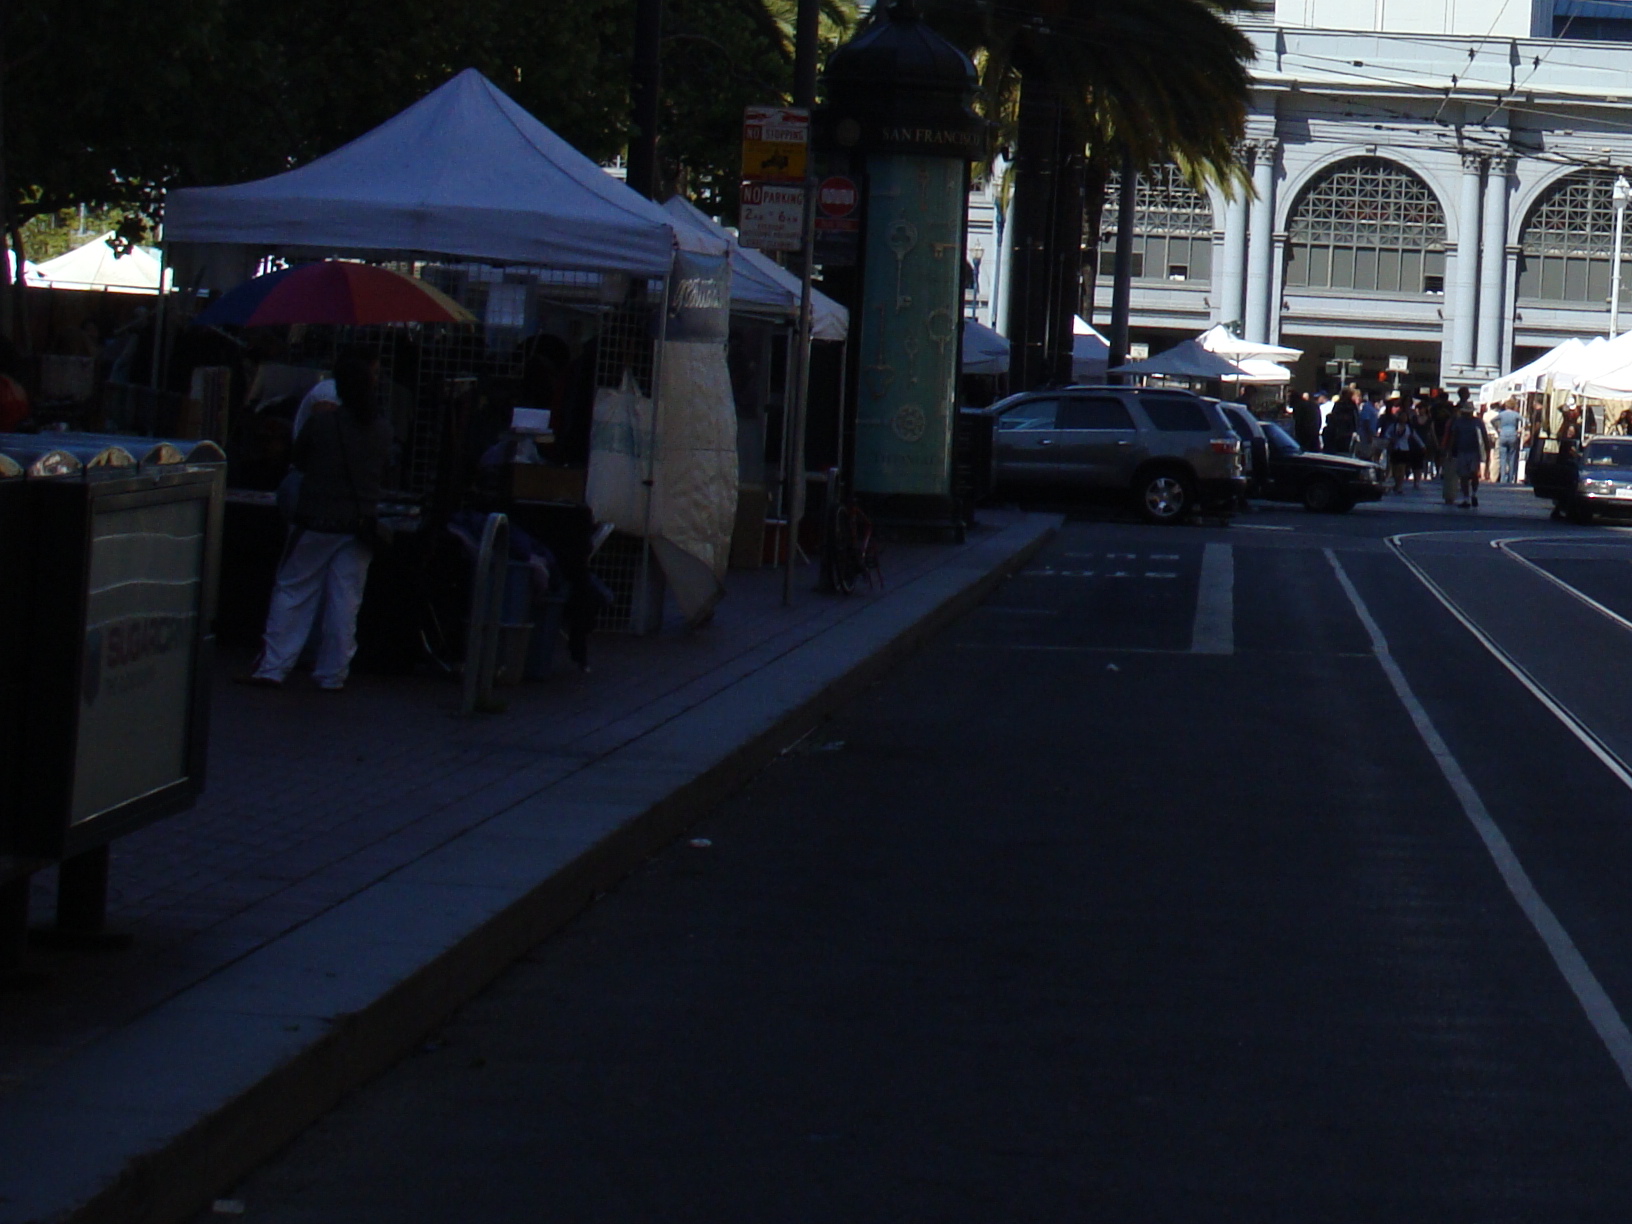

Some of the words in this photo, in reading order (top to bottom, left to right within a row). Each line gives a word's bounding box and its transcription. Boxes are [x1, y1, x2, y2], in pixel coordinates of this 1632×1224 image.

[882, 126, 912, 142] SAN
[914, 128, 981, 146] FRANCISCO
[742, 184, 761, 205] NO
[763, 190, 803, 205] PARKING
